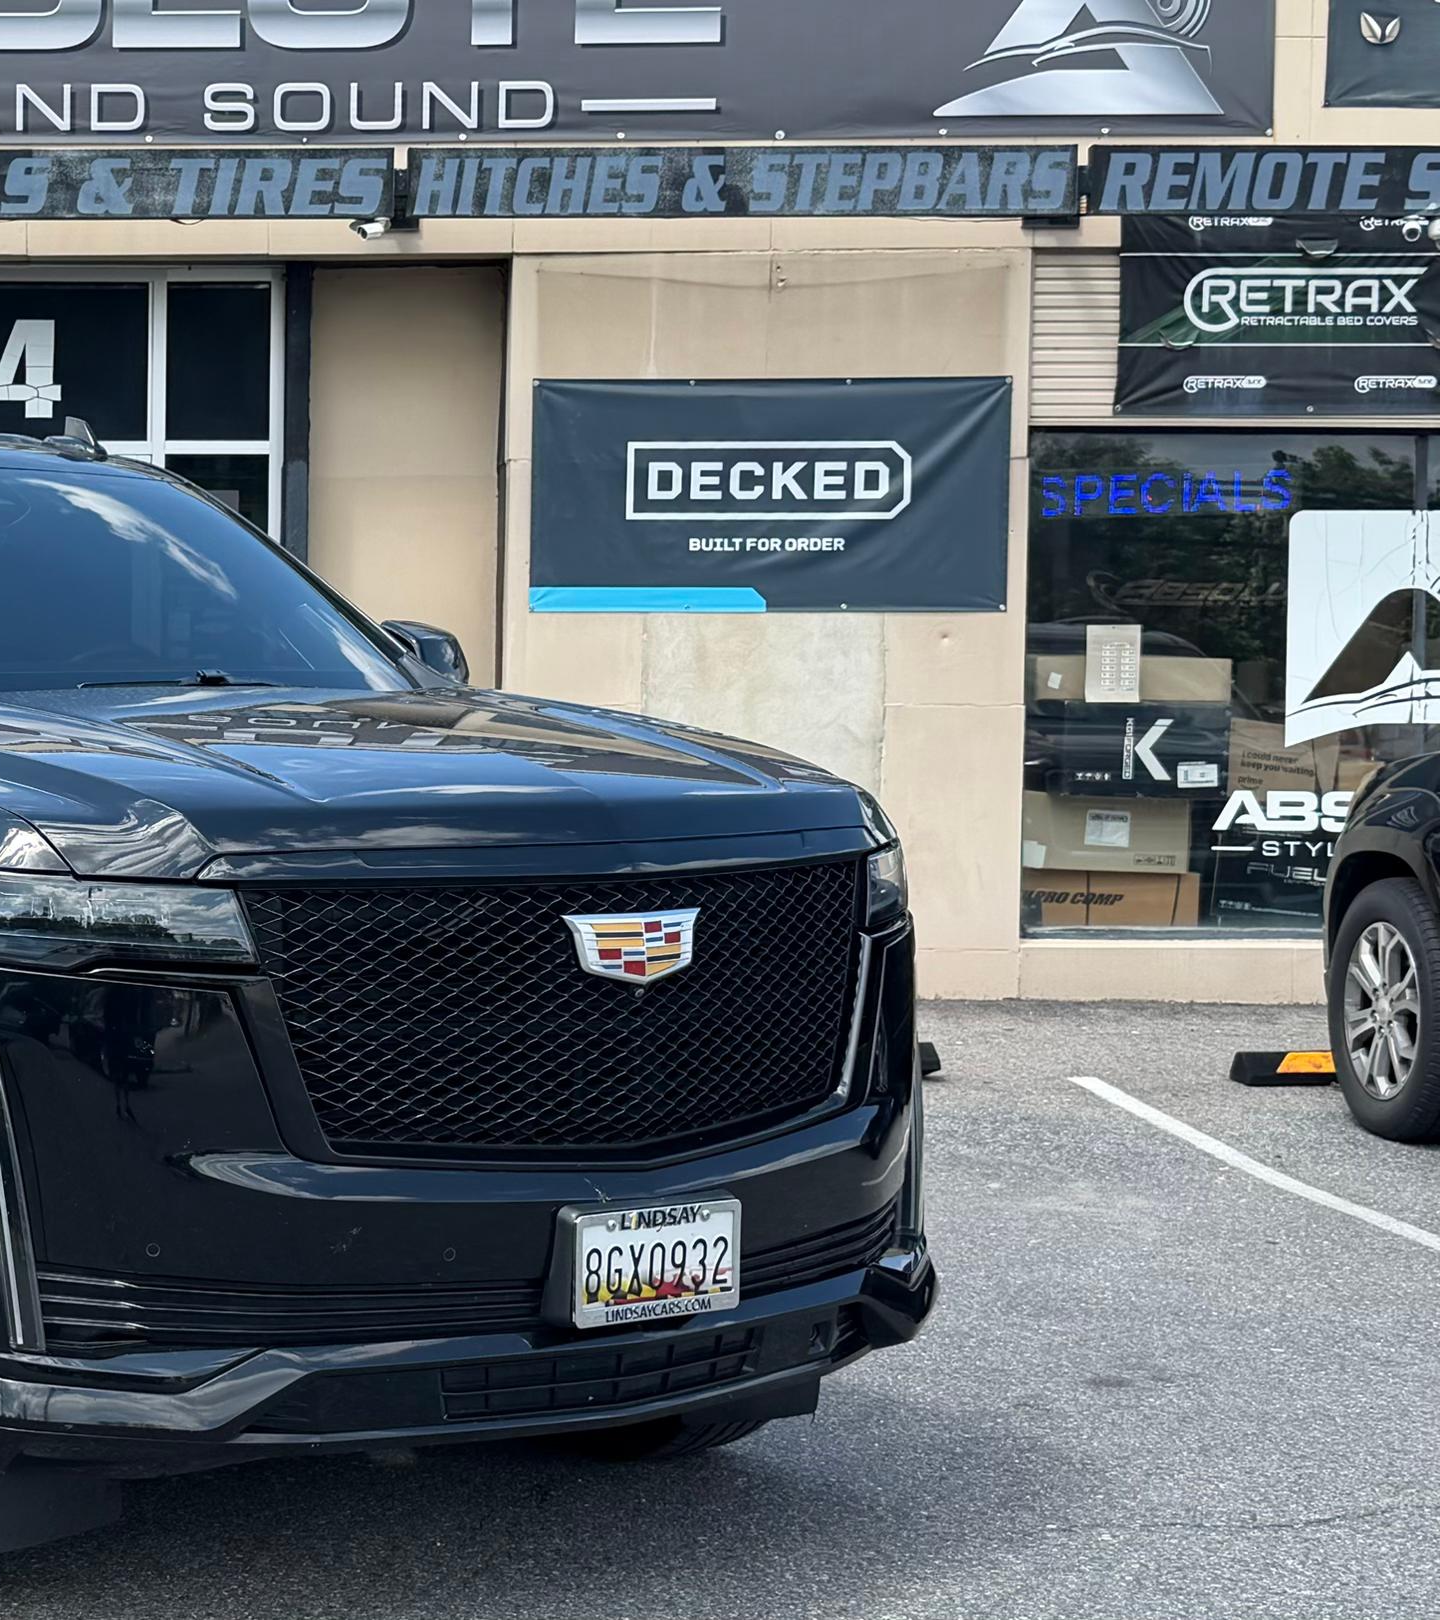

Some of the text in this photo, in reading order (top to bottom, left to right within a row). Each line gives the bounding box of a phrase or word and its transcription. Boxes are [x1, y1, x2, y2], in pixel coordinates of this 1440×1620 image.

[203, 80, 555, 132] SOUND
[77, 158, 133, 214] &
[168, 158, 389, 216] TIRES
[415, 152, 1073, 214] HITCHES & STEPBARS
[1098, 151, 1386, 212] REMOTE
[1186, 274, 1420, 330] RETRAX
[1240, 315, 1418, 326] RETRACTABLE BED COVERS
[1185, 376, 1244, 391] RETRAX
[1355, 376, 1414, 392] RETRAX
[647, 461, 890, 500] DECKED
[1041, 469, 1294, 518] SPECIALS
[688, 536, 846, 552] BUILT FOR ORDER
[1240, 760, 1262, 770] keep
[1263, 763, 1280, 772] you
[1247, 750, 1271, 761] could
[1272, 755, 1299, 764] never
[1238, 774, 1264, 785] prime
[1211, 790, 1355, 833] ABS
[1246, 861, 1328, 882] FUEL
[1070, 892, 1124, 907] COMP
[620, 1204, 702, 1231] LINDSAY
[585, 1235, 729, 1305] 8GX0932
[605, 1298, 712, 1324] LINDSAYCARS.COM
